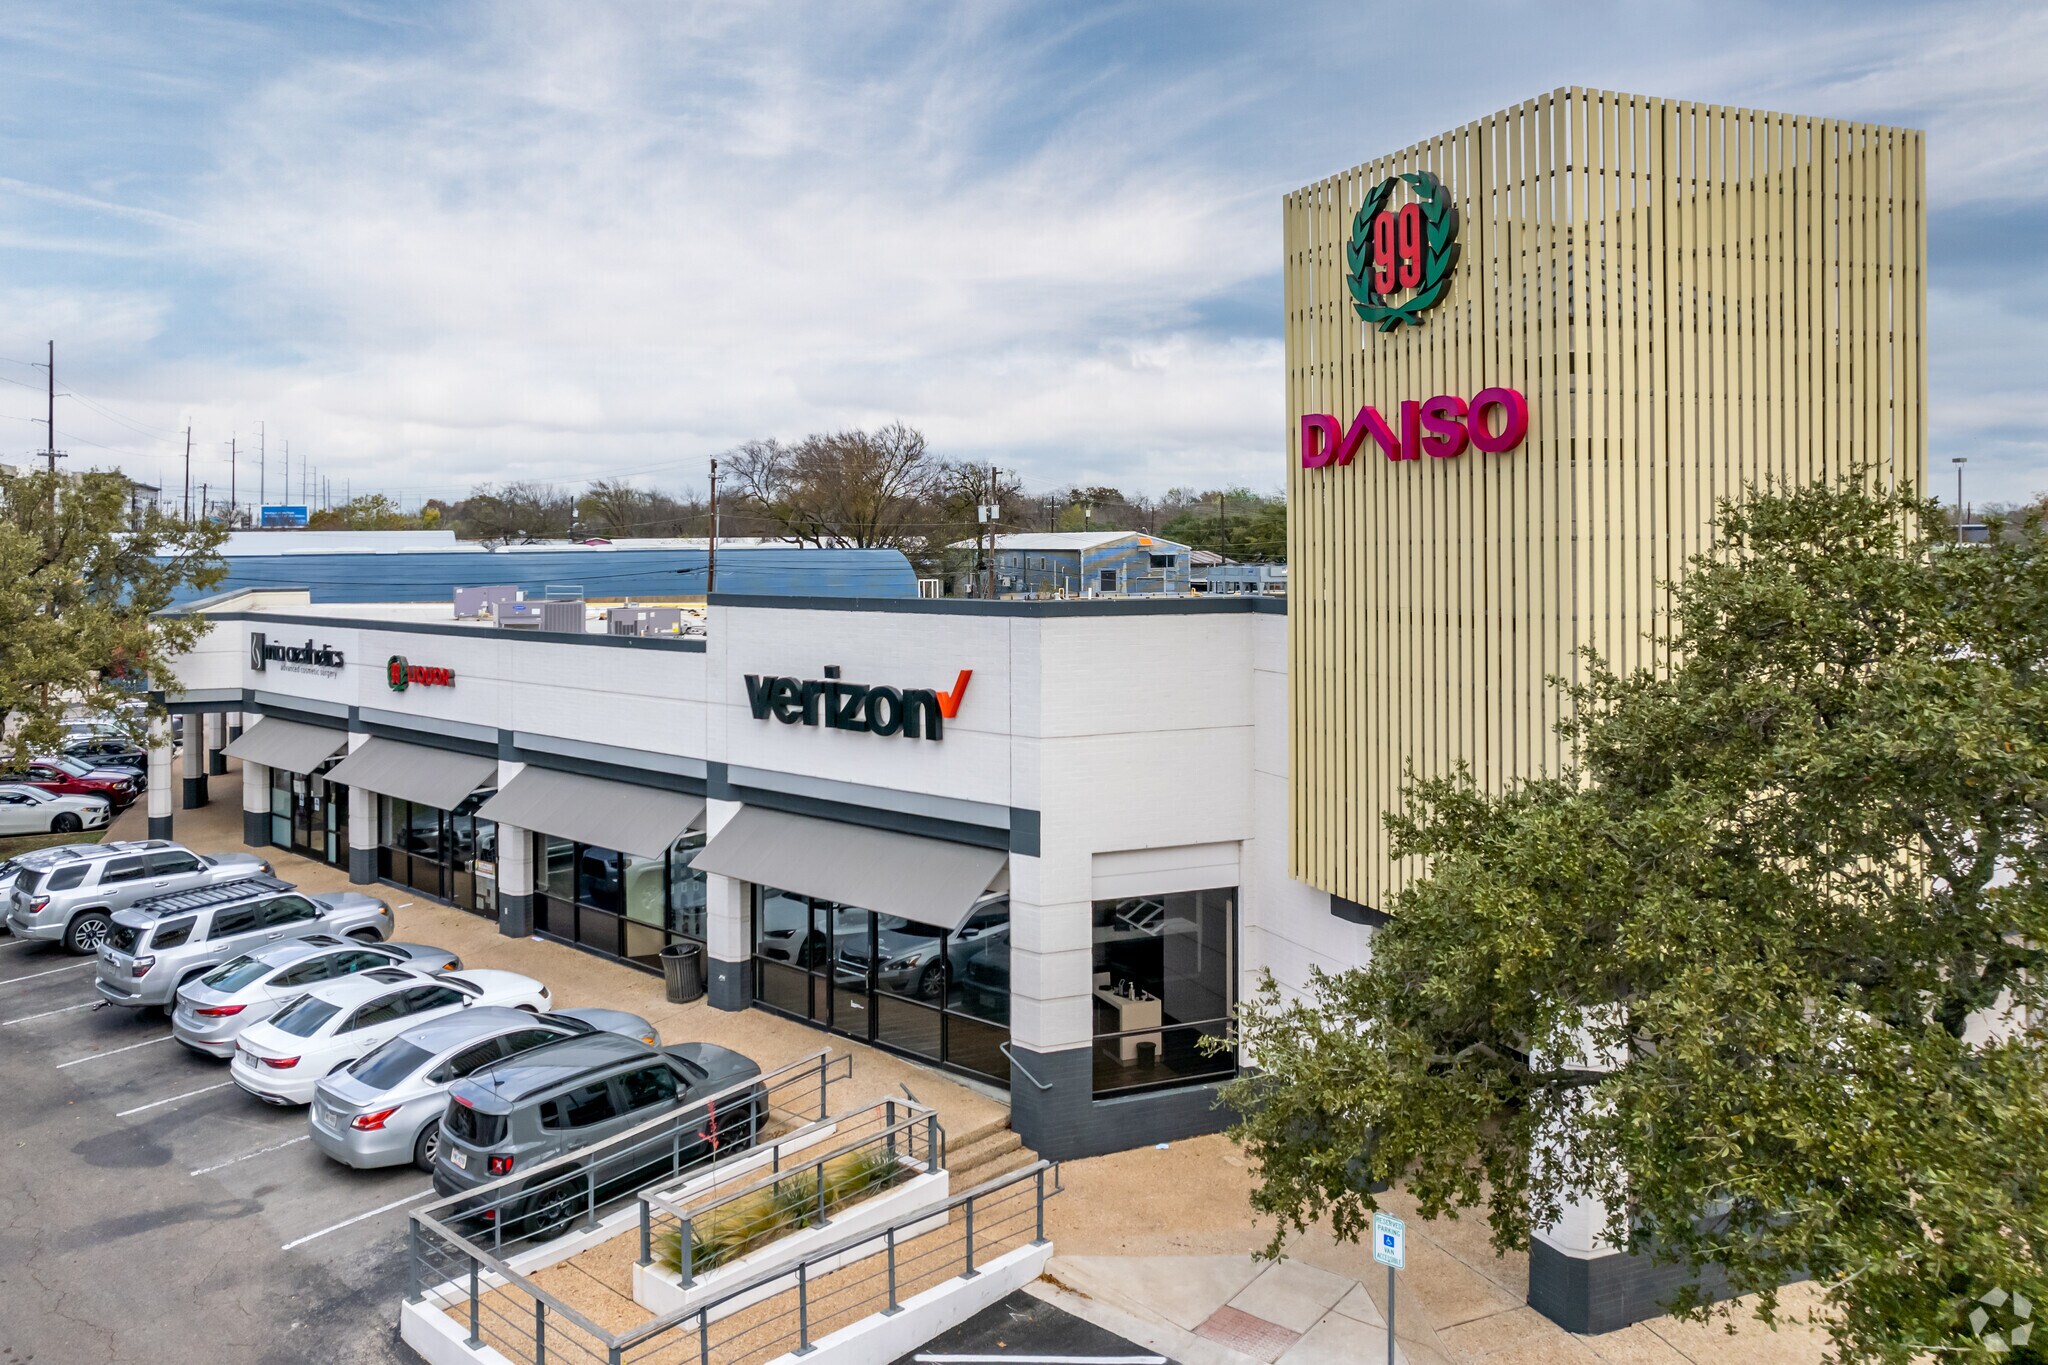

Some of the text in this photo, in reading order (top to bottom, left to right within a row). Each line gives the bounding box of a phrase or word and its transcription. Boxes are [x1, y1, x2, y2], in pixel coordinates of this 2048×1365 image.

[1374, 202, 1426, 295] 99
[1301, 387, 1528, 469] DAISO
[408, 665, 455, 688] LIQUOR
[744, 665, 943, 741] verizon
[1375, 1216, 1403, 1230] RESERVED
[1377, 1224, 1401, 1237] PARKING
[1383, 1247, 1395, 1255] VAN
